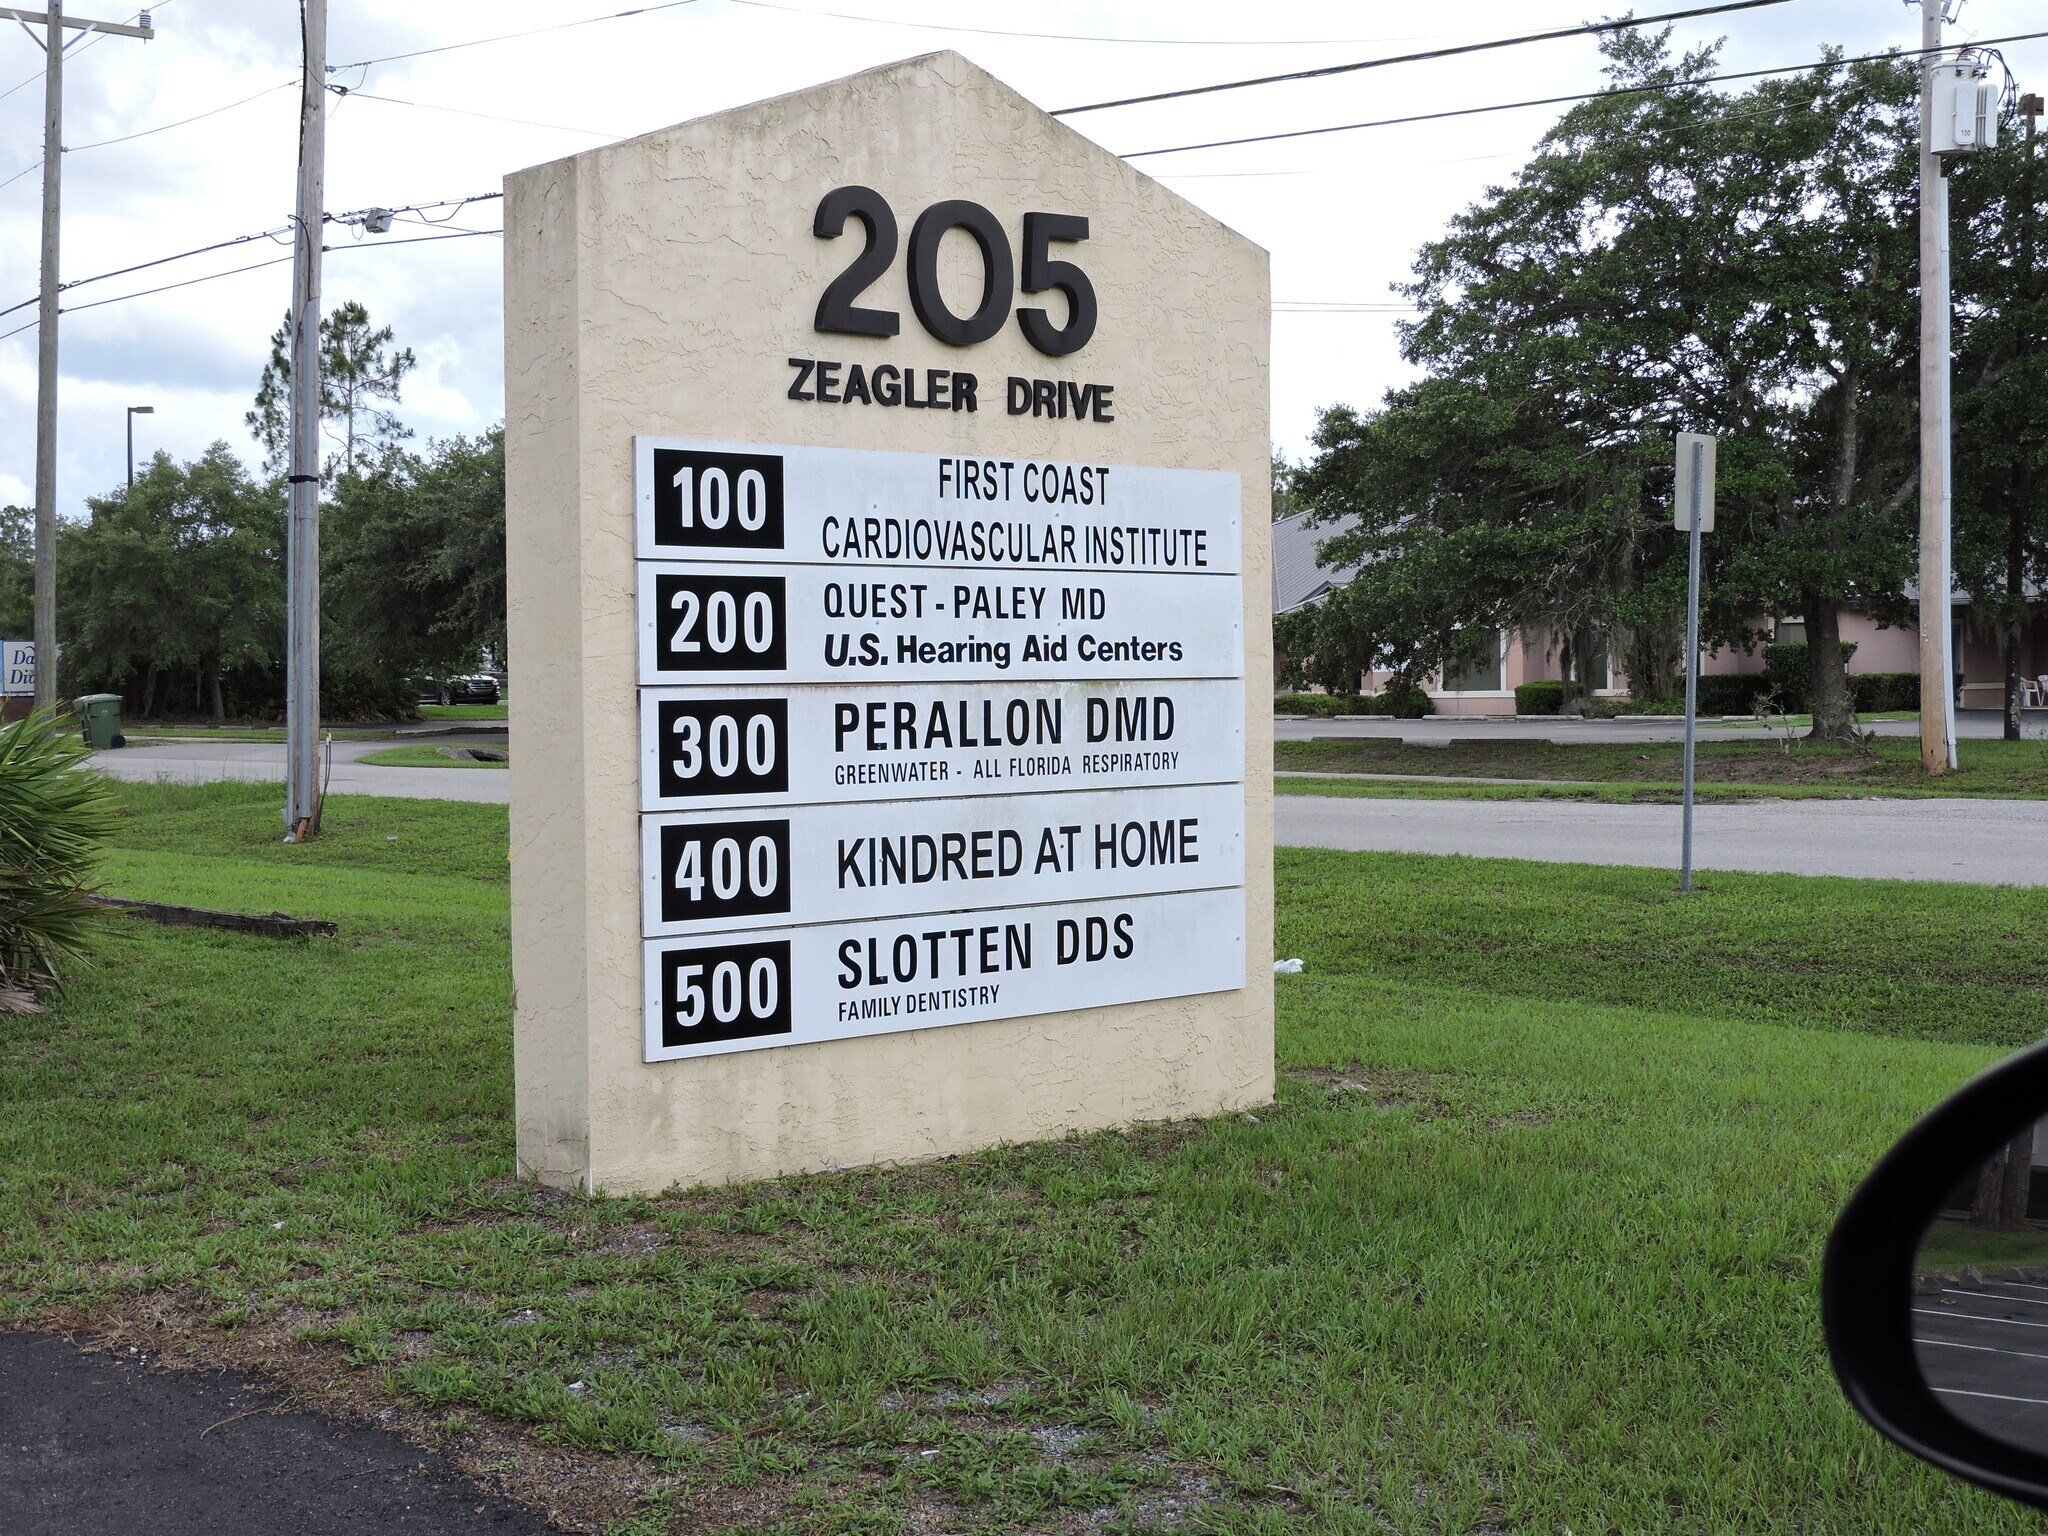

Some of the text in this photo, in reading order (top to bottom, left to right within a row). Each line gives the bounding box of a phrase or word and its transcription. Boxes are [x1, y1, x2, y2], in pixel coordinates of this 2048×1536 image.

[814, 185, 1098, 356] 205
[788, 358, 1115, 423] ZEAGLER DRIVE
[673, 466, 767, 531] 100
[939, 458, 1110, 506] FIRST COAST
[822, 515, 1208, 567] CARDIOVASCULAR INSTITUTE
[670, 590, 773, 654] 200
[823, 582, 928, 619] QUEST
[953, 585, 1047, 620] PALEY
[1061, 587, 1106, 620] MD
[824, 632, 1183, 670] U.S. Hearing Aid Centers
[672, 713, 776, 779] 300
[834, 696, 1175, 753] PERALLON DMD
[834, 760, 949, 786] GREENWATER
[973, 758, 1002, 779] ALL
[1009, 755, 1072, 778] FLORIDA
[1082, 751, 1179, 774] RESPIRATORY
[674, 835, 778, 902] 400
[837, 817, 1199, 889] KINDRED AT HOME
[837, 913, 1134, 990] SLOTTEN DDS
[676, 957, 778, 1027] 500
[838, 984, 1000, 1022] FAMILY DENTISTRY
